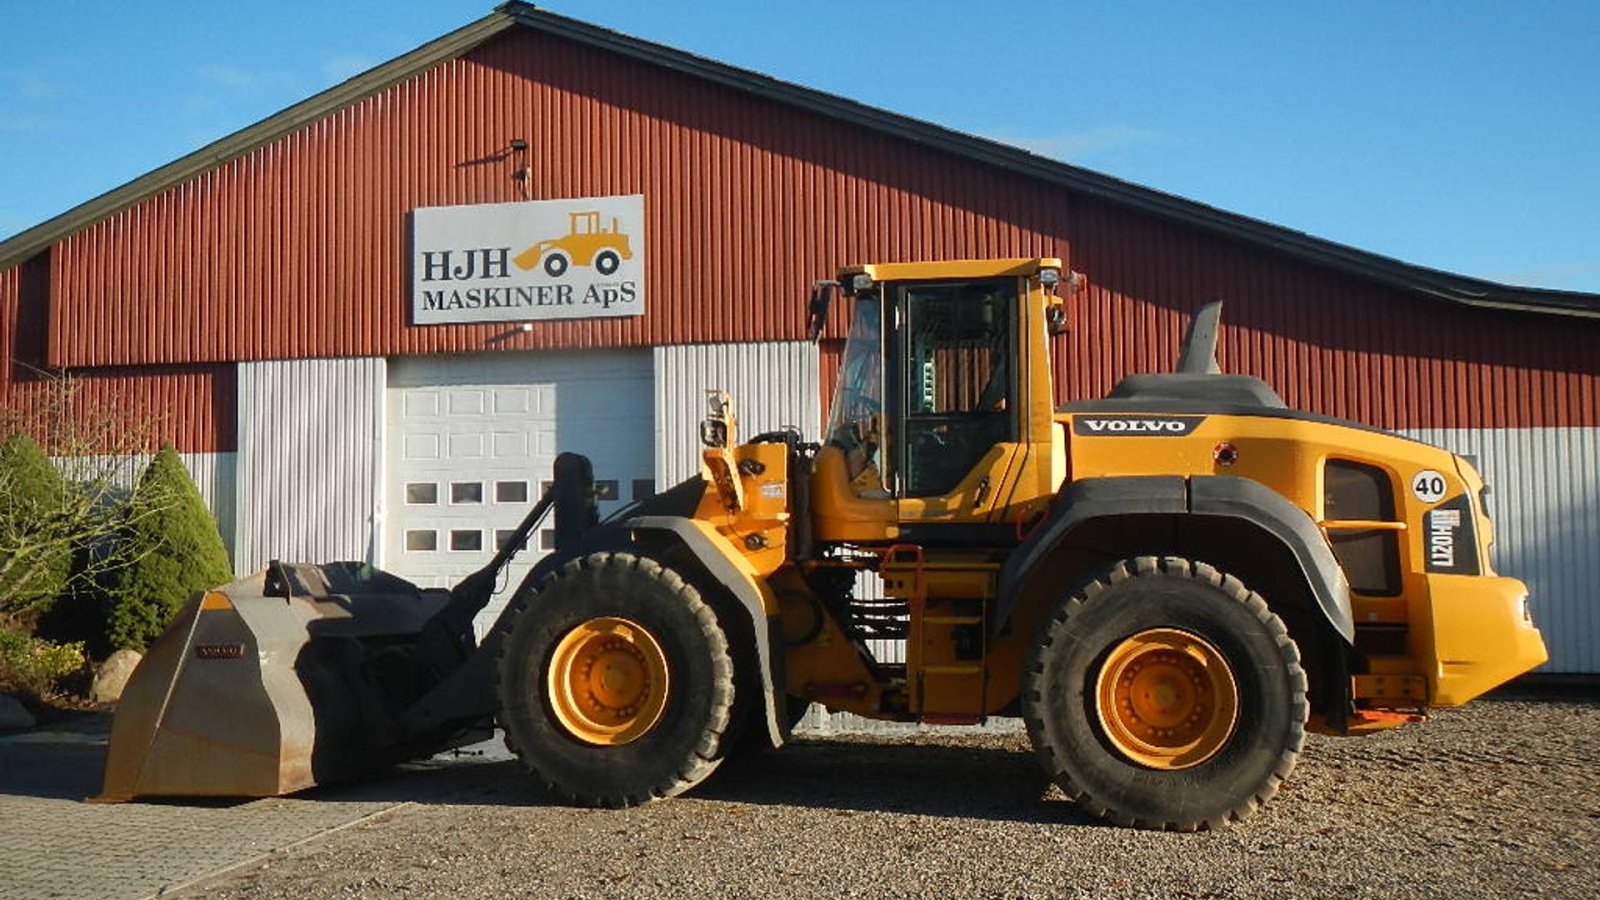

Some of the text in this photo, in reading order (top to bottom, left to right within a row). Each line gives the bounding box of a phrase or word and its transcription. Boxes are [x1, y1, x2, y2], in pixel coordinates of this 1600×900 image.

[421, 248, 512, 282] HJH
[421, 281, 636, 311] MASKINER ApS
[1083, 420, 1186, 431] VOLVO
[1415, 477, 1444, 495] 40
[1430, 526, 1454, 566] L120H
